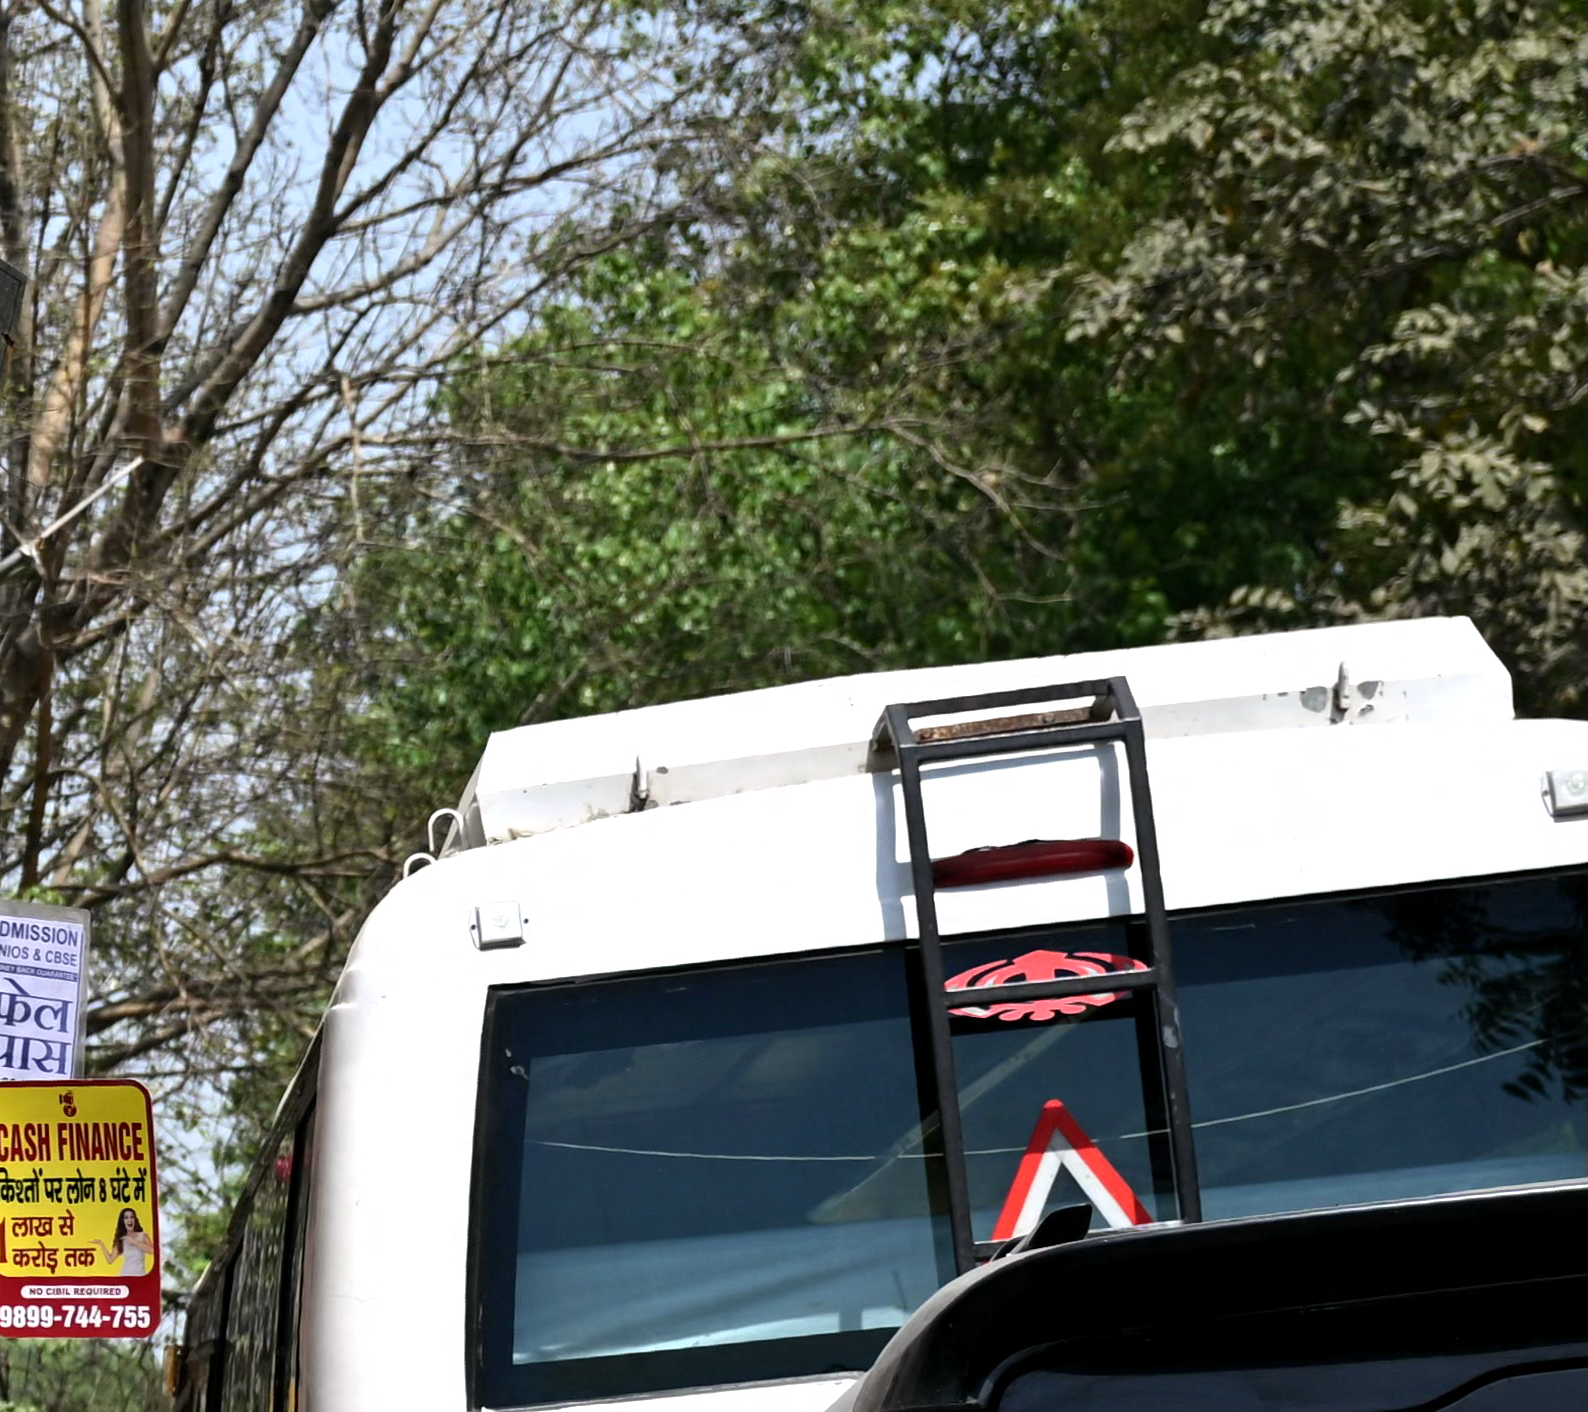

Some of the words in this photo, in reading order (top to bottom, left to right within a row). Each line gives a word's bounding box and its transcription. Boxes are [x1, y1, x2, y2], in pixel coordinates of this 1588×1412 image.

[33, 948, 41, 961] &
[45, 950, 77, 966] CBSE
[59, 1122, 144, 1161] FINANCE
[44, 1177, 62, 1203] पर
[66, 1168, 95, 1204] लोन
[99, 1179, 106, 1203] 8
[110, 1168, 130, 1203] घंटे
[133, 1168, 147, 1202] में
[12, 1217, 53, 1237] लाख
[58, 1209, 75, 1236] से
[12, 1241, 59, 1274] करोड़
[64, 1248, 96, 1267] तक
[29, 1288, 44, 1296] NO
[46, 1288, 71, 1296] CIBIL
[74, 1287, 121, 1296] REQUIRED
[0, 1305, 150, 1328] 9899-744-755
